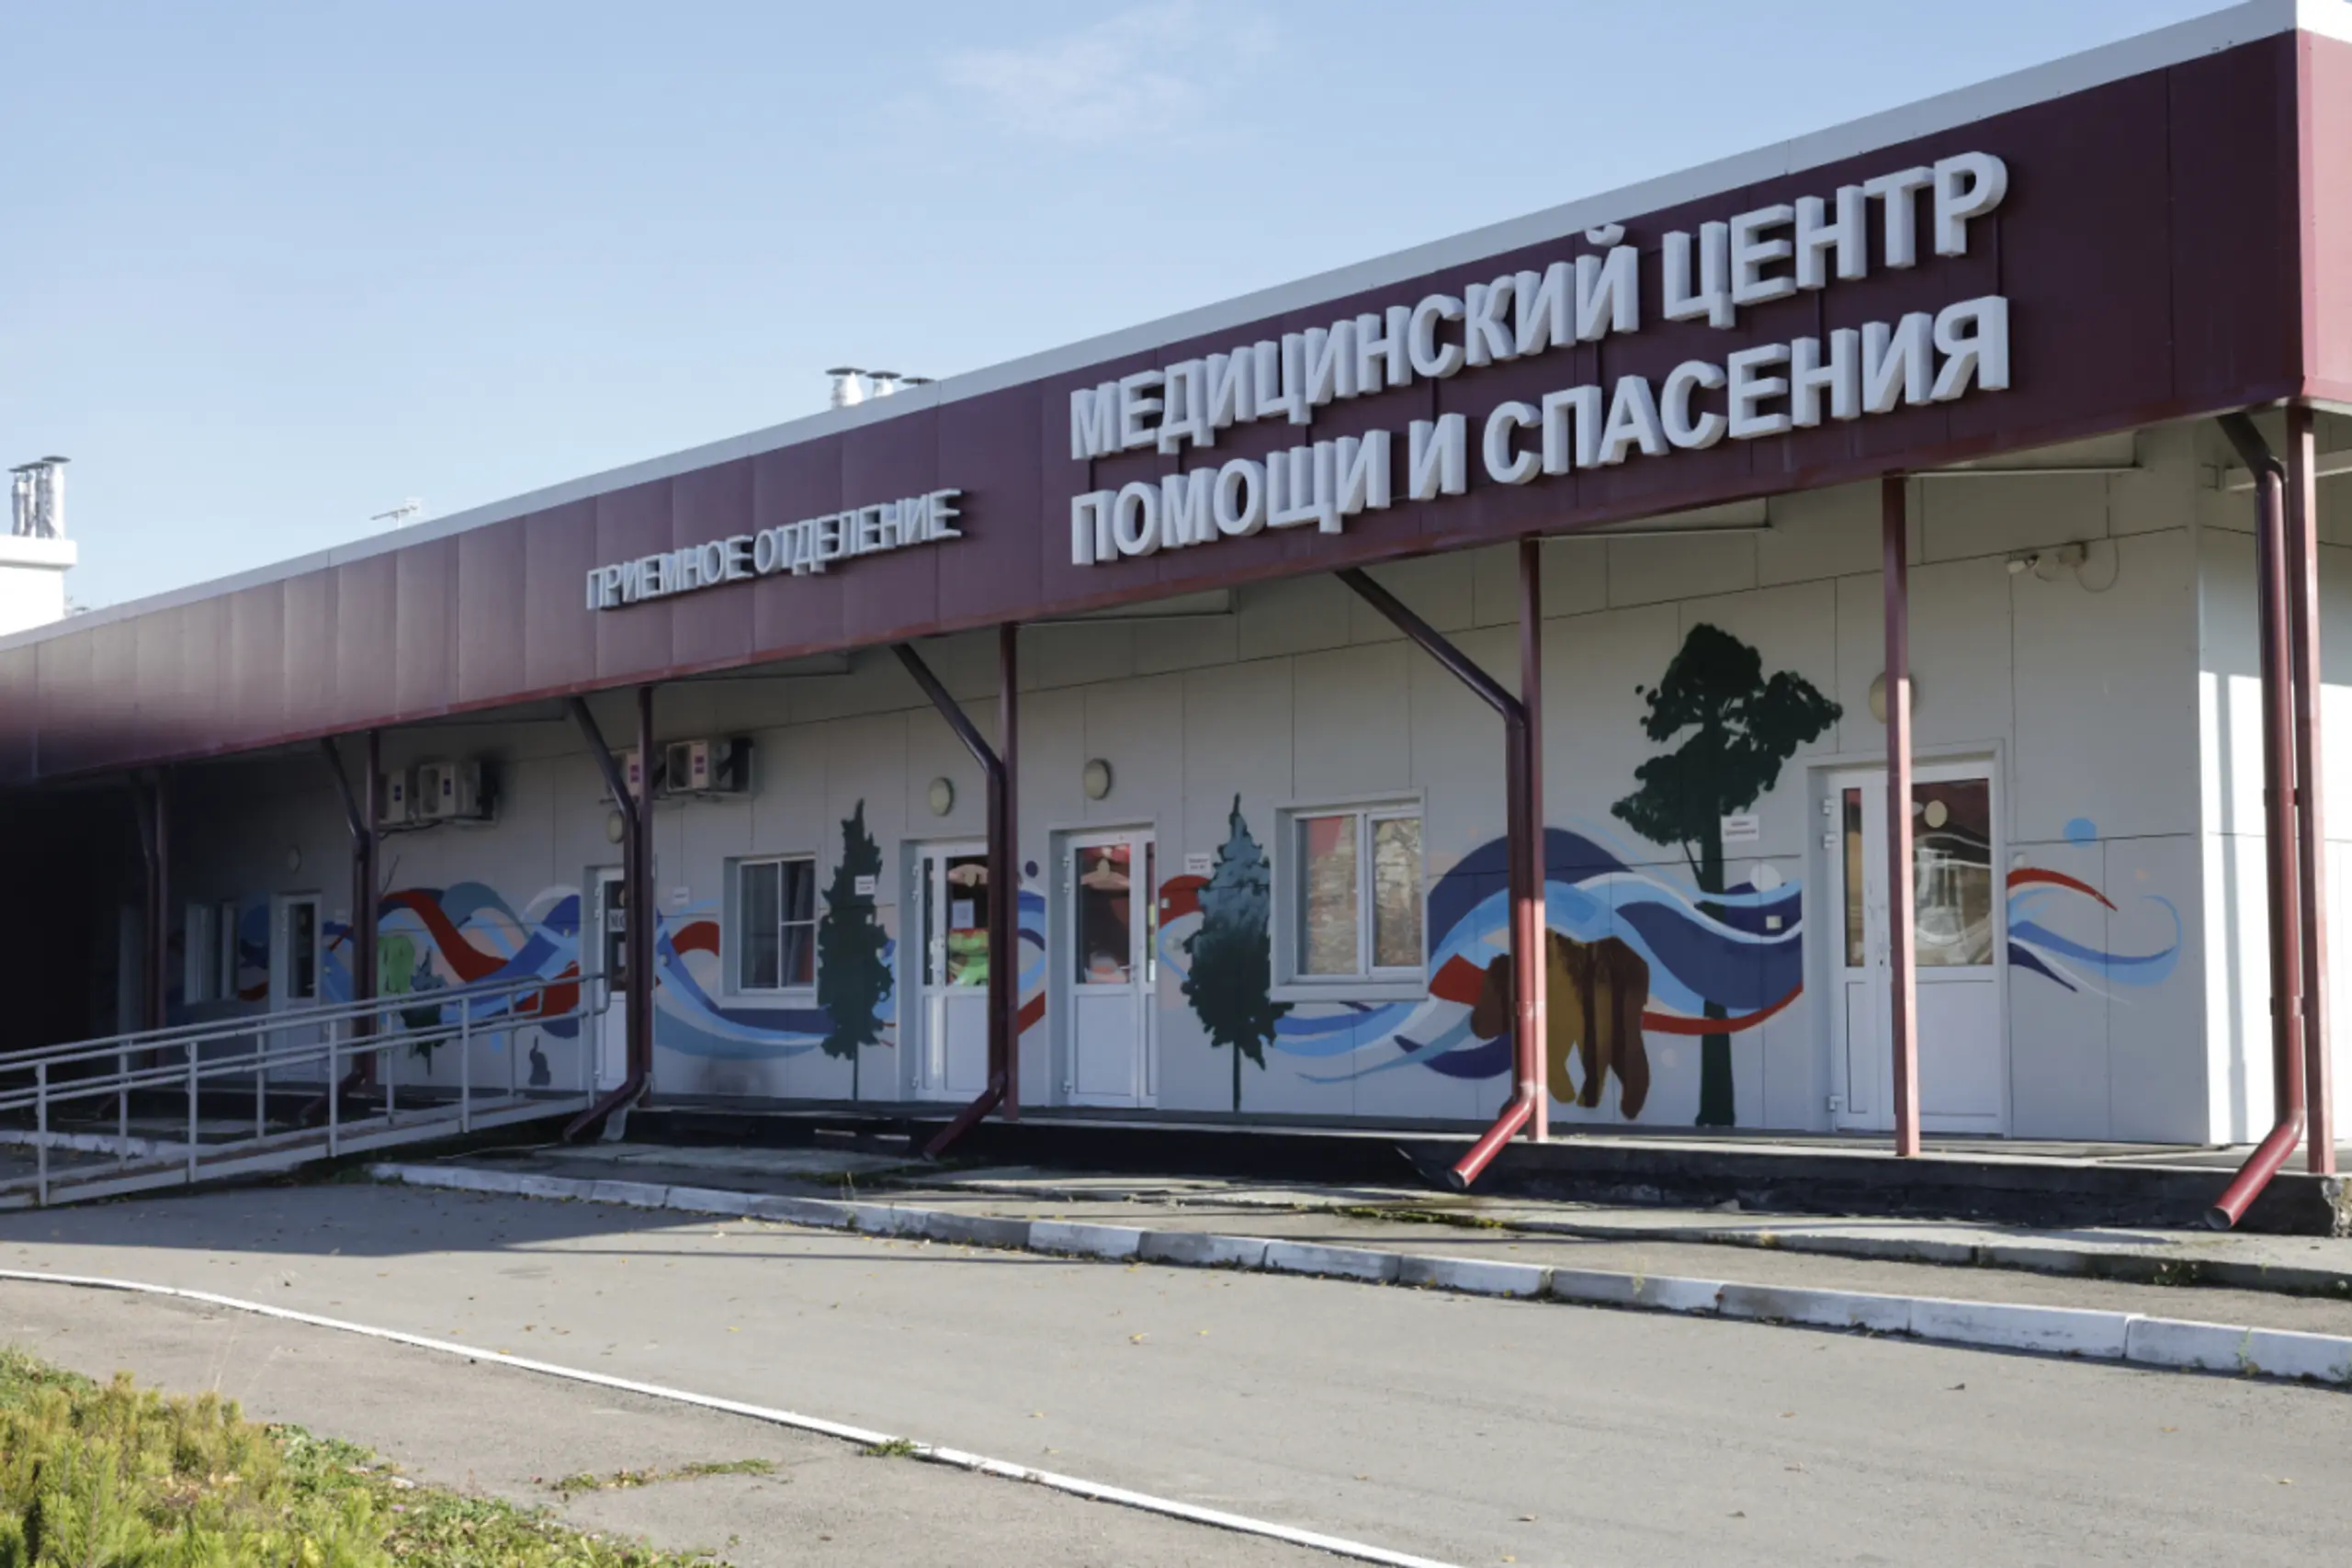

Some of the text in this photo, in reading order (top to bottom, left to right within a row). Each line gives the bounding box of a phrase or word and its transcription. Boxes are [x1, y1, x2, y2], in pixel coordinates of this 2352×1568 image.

[1070, 151, 2008, 460] МЕДИЦИНСКИЙ ЦЕНТР
[1070, 294, 2010, 566] ПОМОЩИ И СПАСЕНИЯ
[586, 488, 962, 609] ПРИЕМНОЕ ОТДЕЛЕНИЕ
